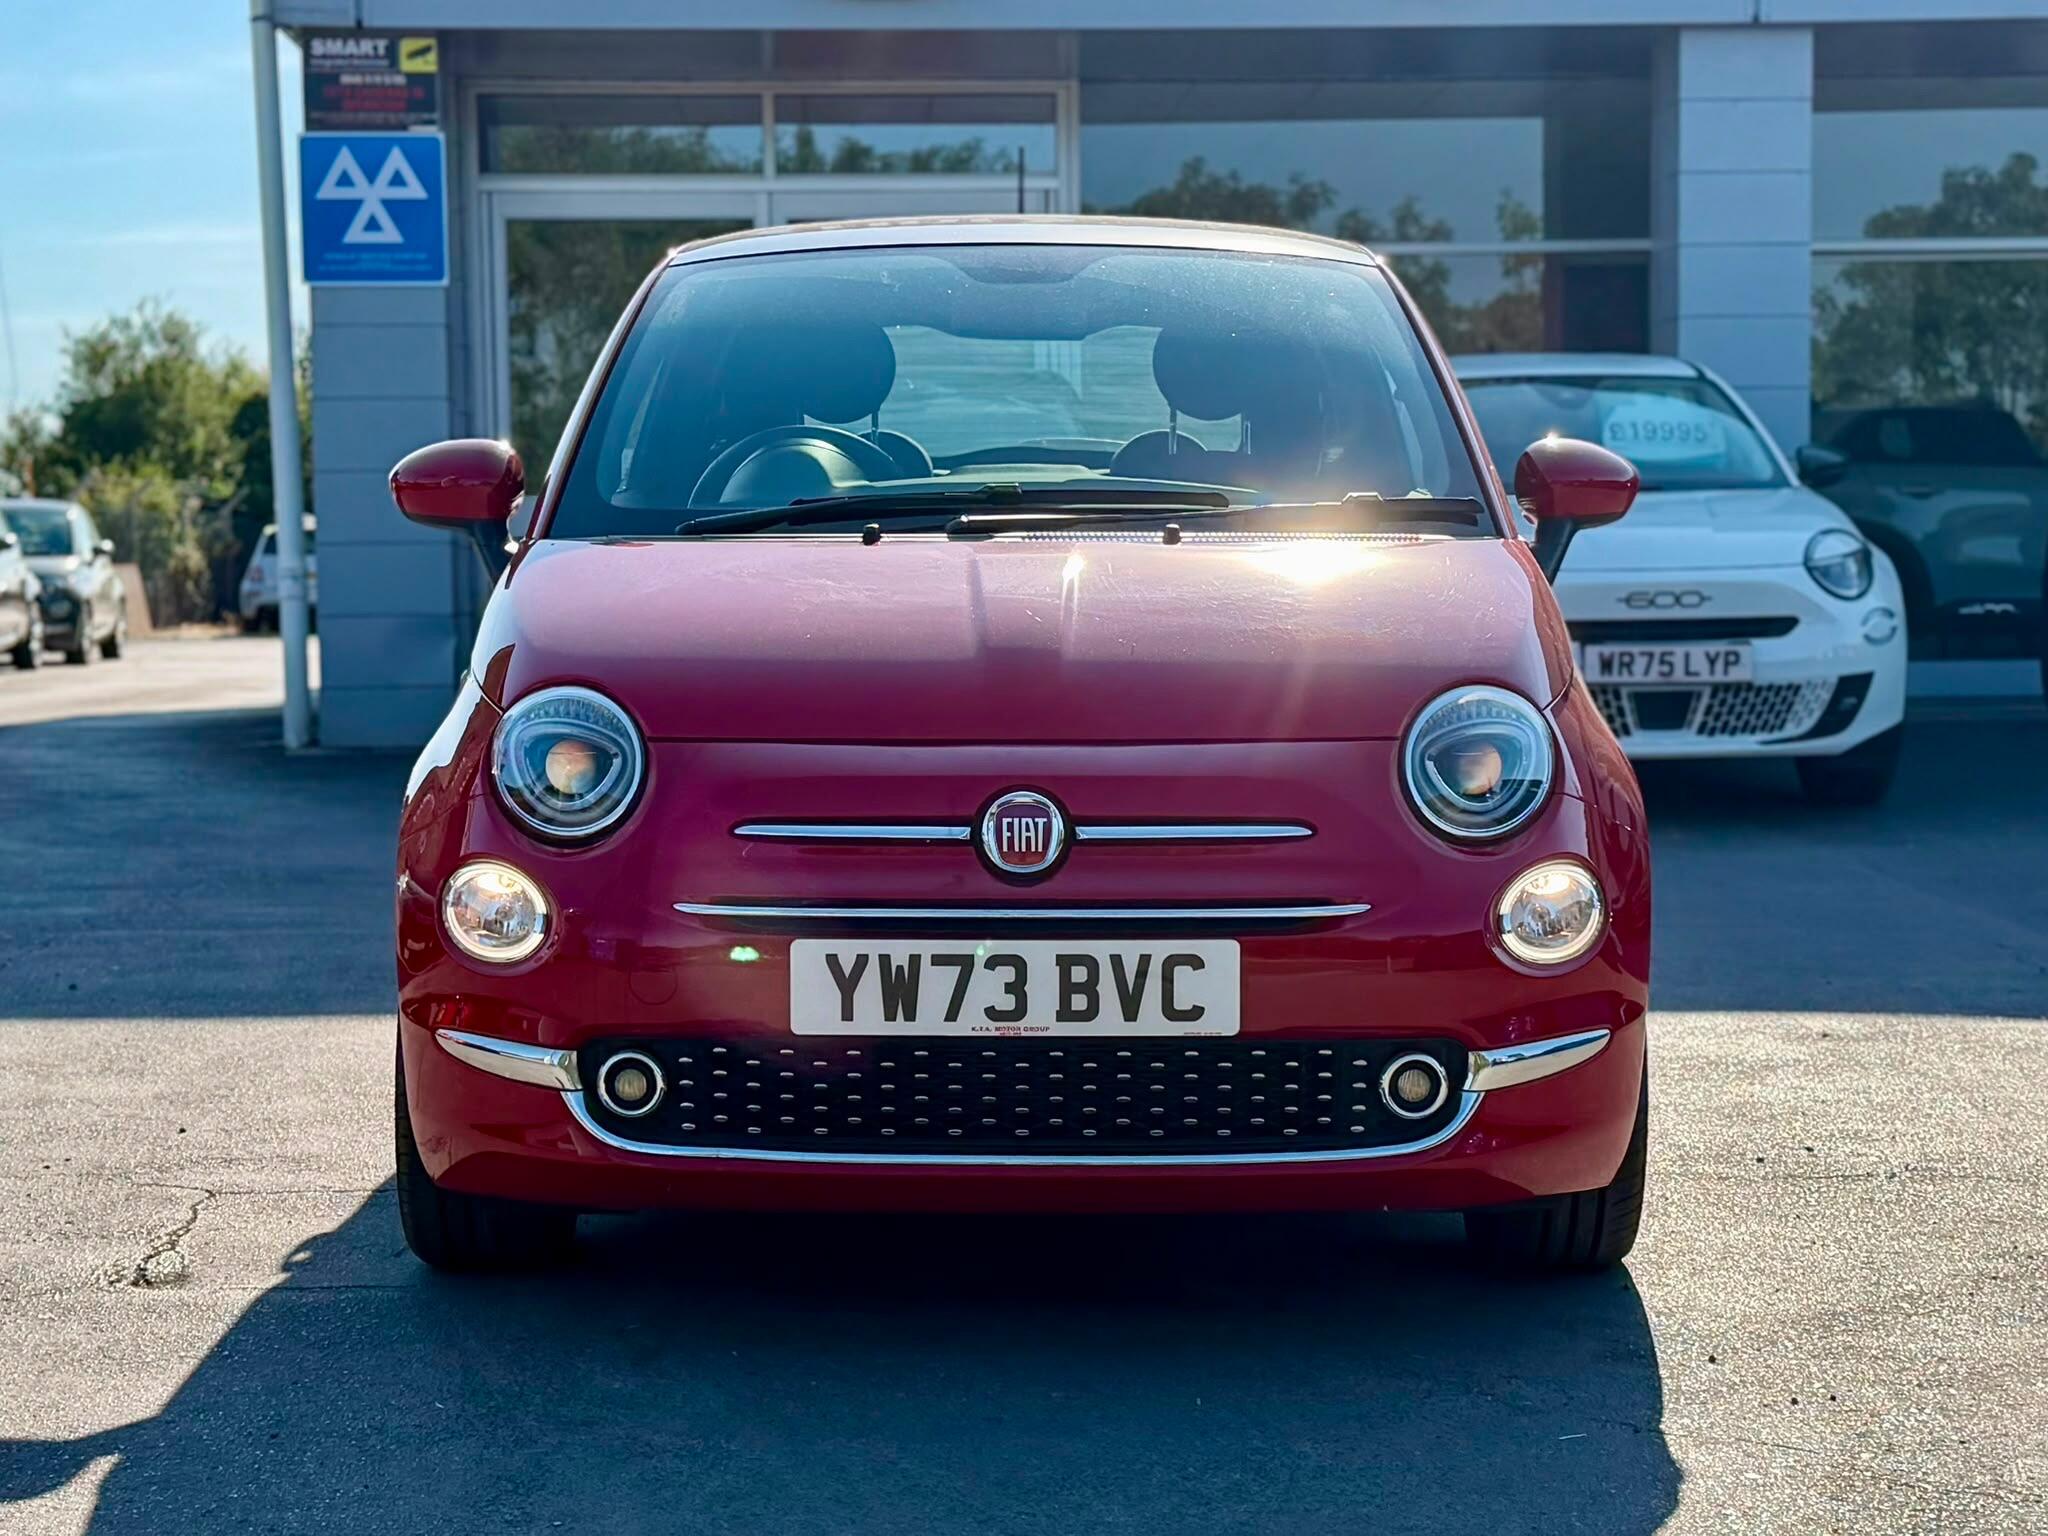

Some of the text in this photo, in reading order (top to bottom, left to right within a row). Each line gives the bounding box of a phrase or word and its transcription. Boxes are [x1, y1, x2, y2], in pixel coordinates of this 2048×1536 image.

[310, 38, 389, 56] SMART
[1609, 421, 1708, 444] £19995
[1618, 590, 1710, 609] 600
[1598, 650, 1741, 677] WR75 LYP
[1002, 817, 1048, 853] FIAT
[825, 953, 1206, 1022] YW73 BVC
